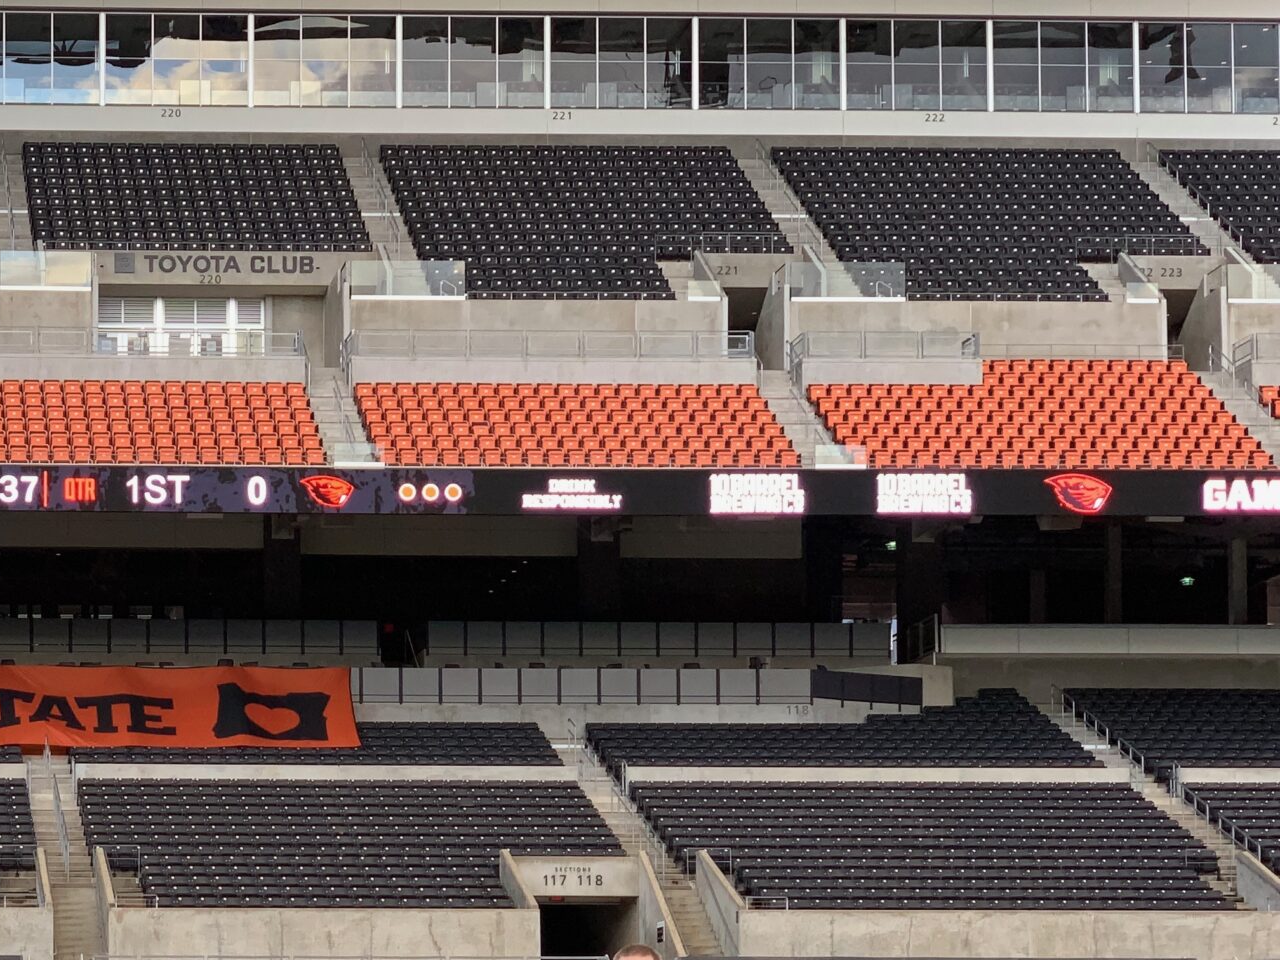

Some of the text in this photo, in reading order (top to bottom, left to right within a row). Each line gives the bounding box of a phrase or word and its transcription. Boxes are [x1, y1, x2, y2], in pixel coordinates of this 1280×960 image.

[161, 109, 181, 118] 220
[552, 111, 572, 121] 221
[925, 113, 946, 122] 222
[143, 255, 315, 274] TOYOTA CLUB
[716, 265, 738, 276] 221
[1161, 267, 1183, 278] 223
[199, 274, 221, 284] 220
[63, 474, 190, 504] QTR 1ST
[247, 475, 267, 505] 0
[786, 705, 809, 715] 118
[543, 875, 603, 887] 117 118
